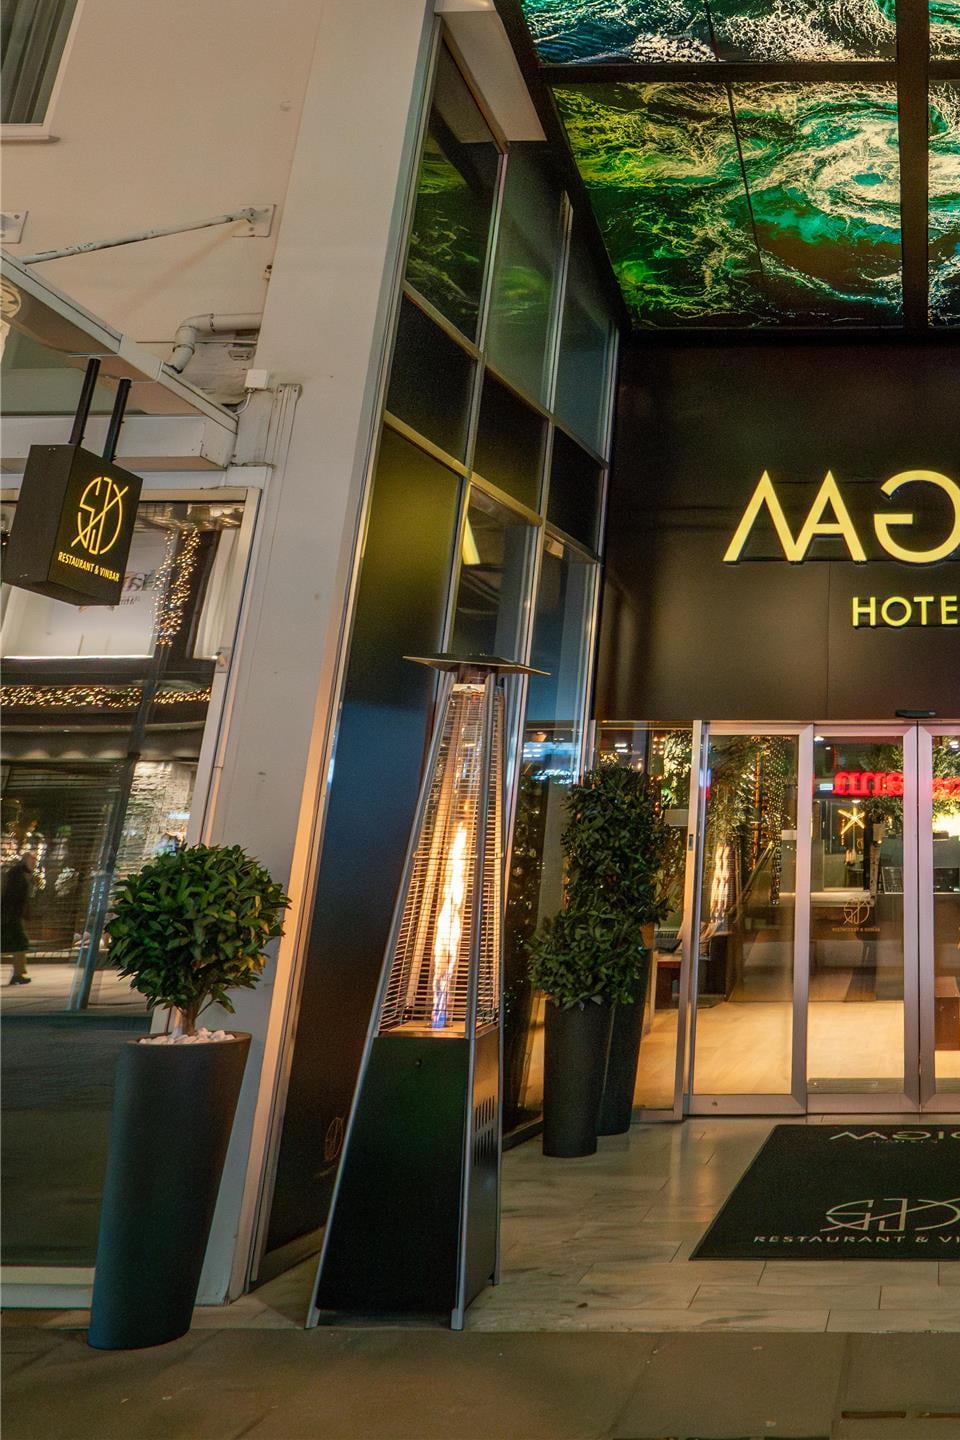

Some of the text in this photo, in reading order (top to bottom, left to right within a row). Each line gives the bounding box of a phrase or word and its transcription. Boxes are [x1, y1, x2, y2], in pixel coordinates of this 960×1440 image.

[58, 551, 95, 573] RESTAURANT
[94, 565, 100, 575] &
[99, 567, 120, 582] VINBAR
[753, 1235, 905, 1244] RESTAURANT
[915, 1235, 929, 1244] &
